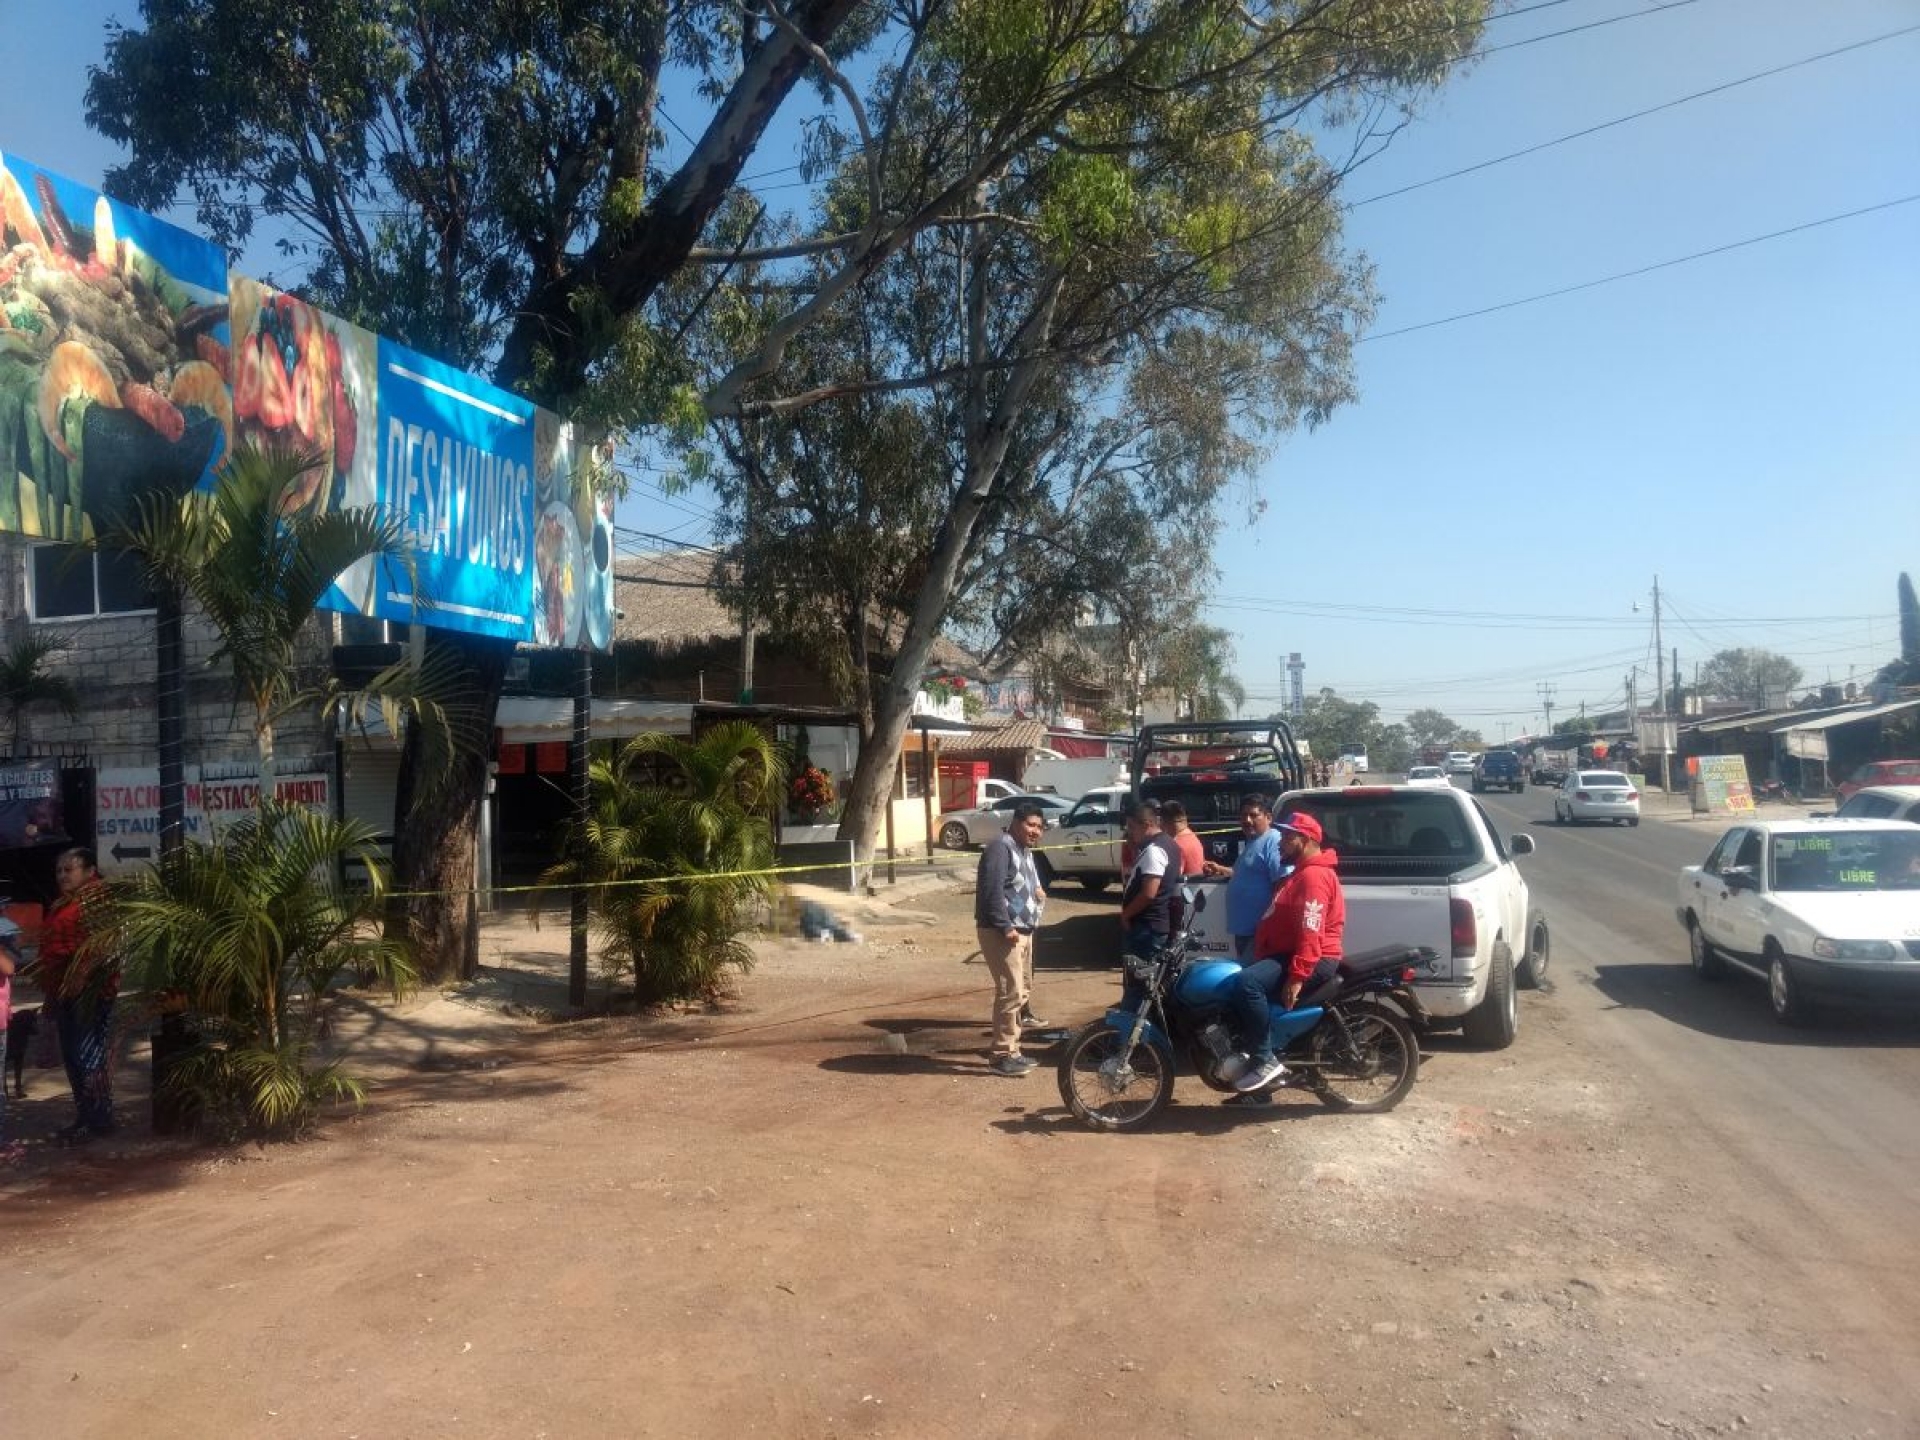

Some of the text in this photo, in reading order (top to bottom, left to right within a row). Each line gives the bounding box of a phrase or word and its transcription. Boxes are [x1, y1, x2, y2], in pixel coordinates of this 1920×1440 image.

[385, 416, 528, 574] DESAYUNOS
[1798, 838, 1832, 850] LIBRE
[1839, 869, 1876, 883] LIBRE
